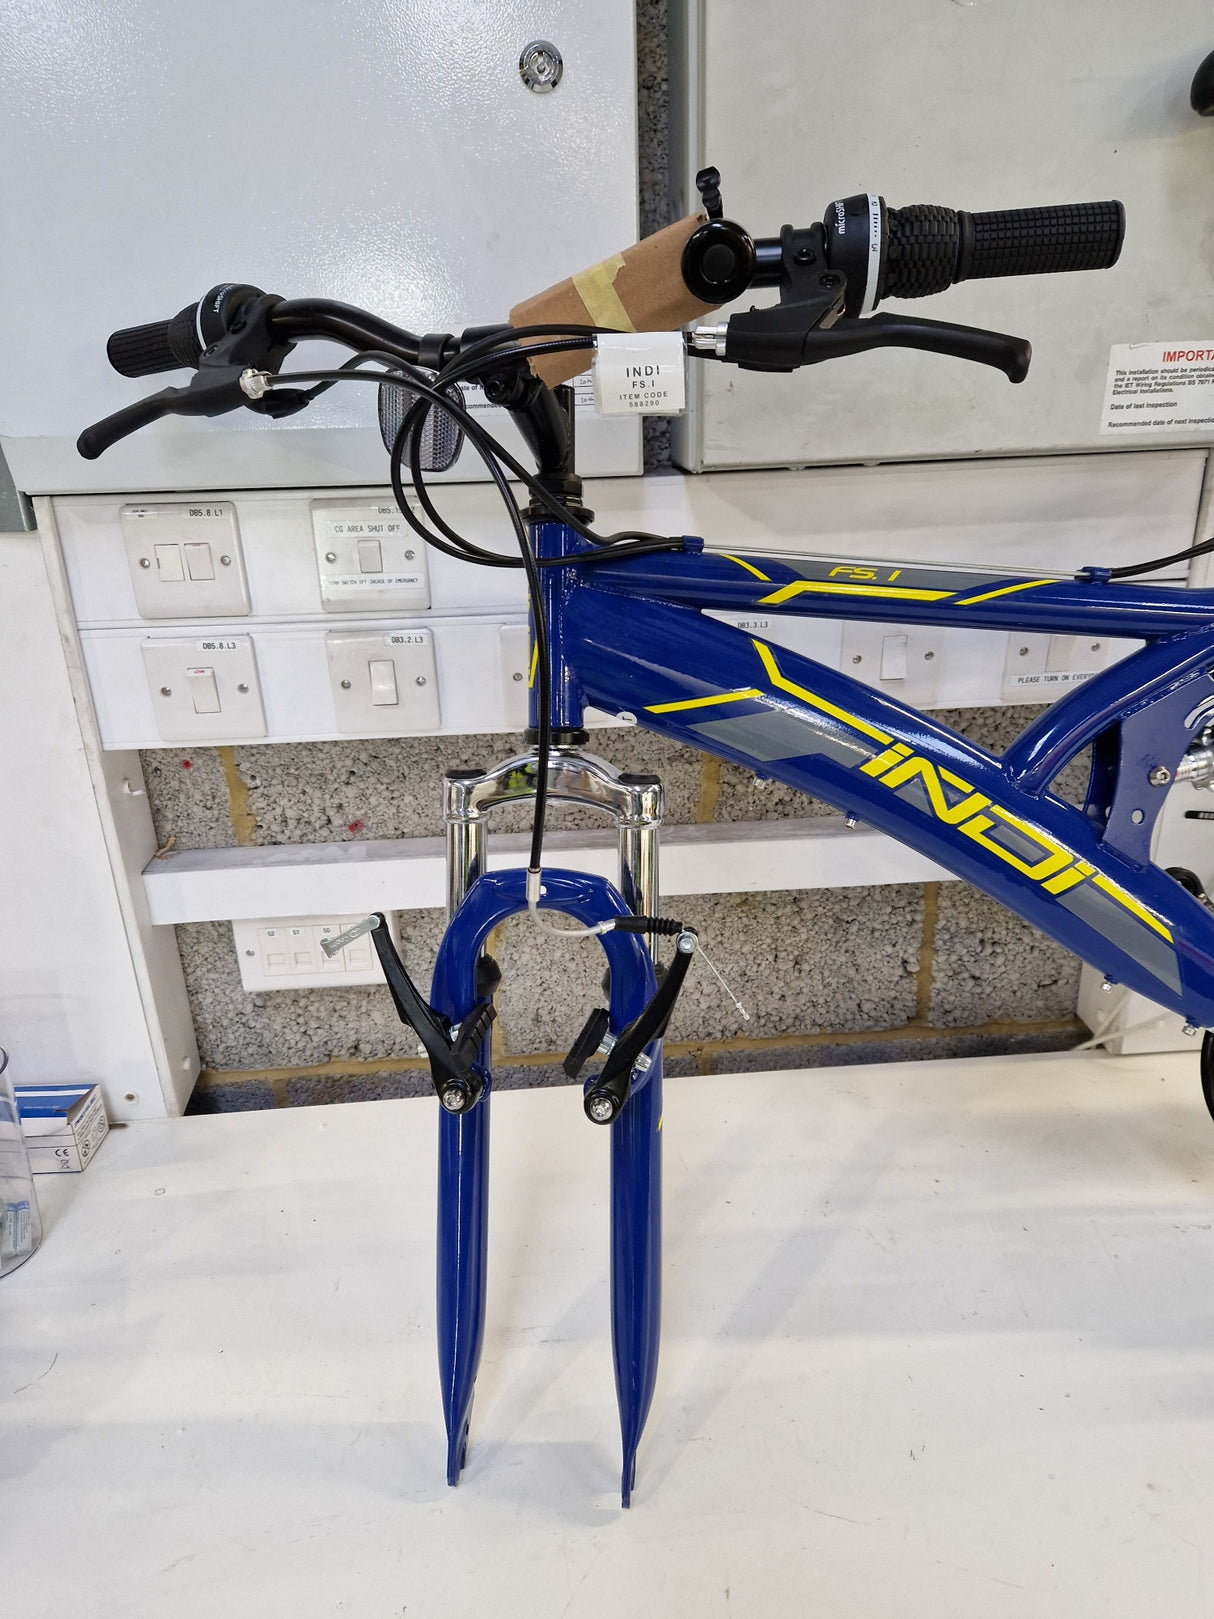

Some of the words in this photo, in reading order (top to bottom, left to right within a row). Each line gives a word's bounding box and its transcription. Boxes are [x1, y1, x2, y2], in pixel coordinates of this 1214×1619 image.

[626, 365, 660, 378] INDI
[644, 391, 668, 399] CODE
[1110, 403, 1124, 411] Date
[1146, 401, 1177, 409] inspection
[1108, 420, 1152, 428] Recommended
[189, 509, 223, 517] DB5.8.L1
[347, 525, 364, 533] AREA
[367, 524, 384, 532] SHUT
[387, 524, 401, 532] OFF
[391, 635, 424, 644] DB3.2.L3
[202, 641, 237, 650] DB5.8.L3
[1017, 675, 1040, 684] PLEASE
[1044, 674, 1059, 682] TURN
